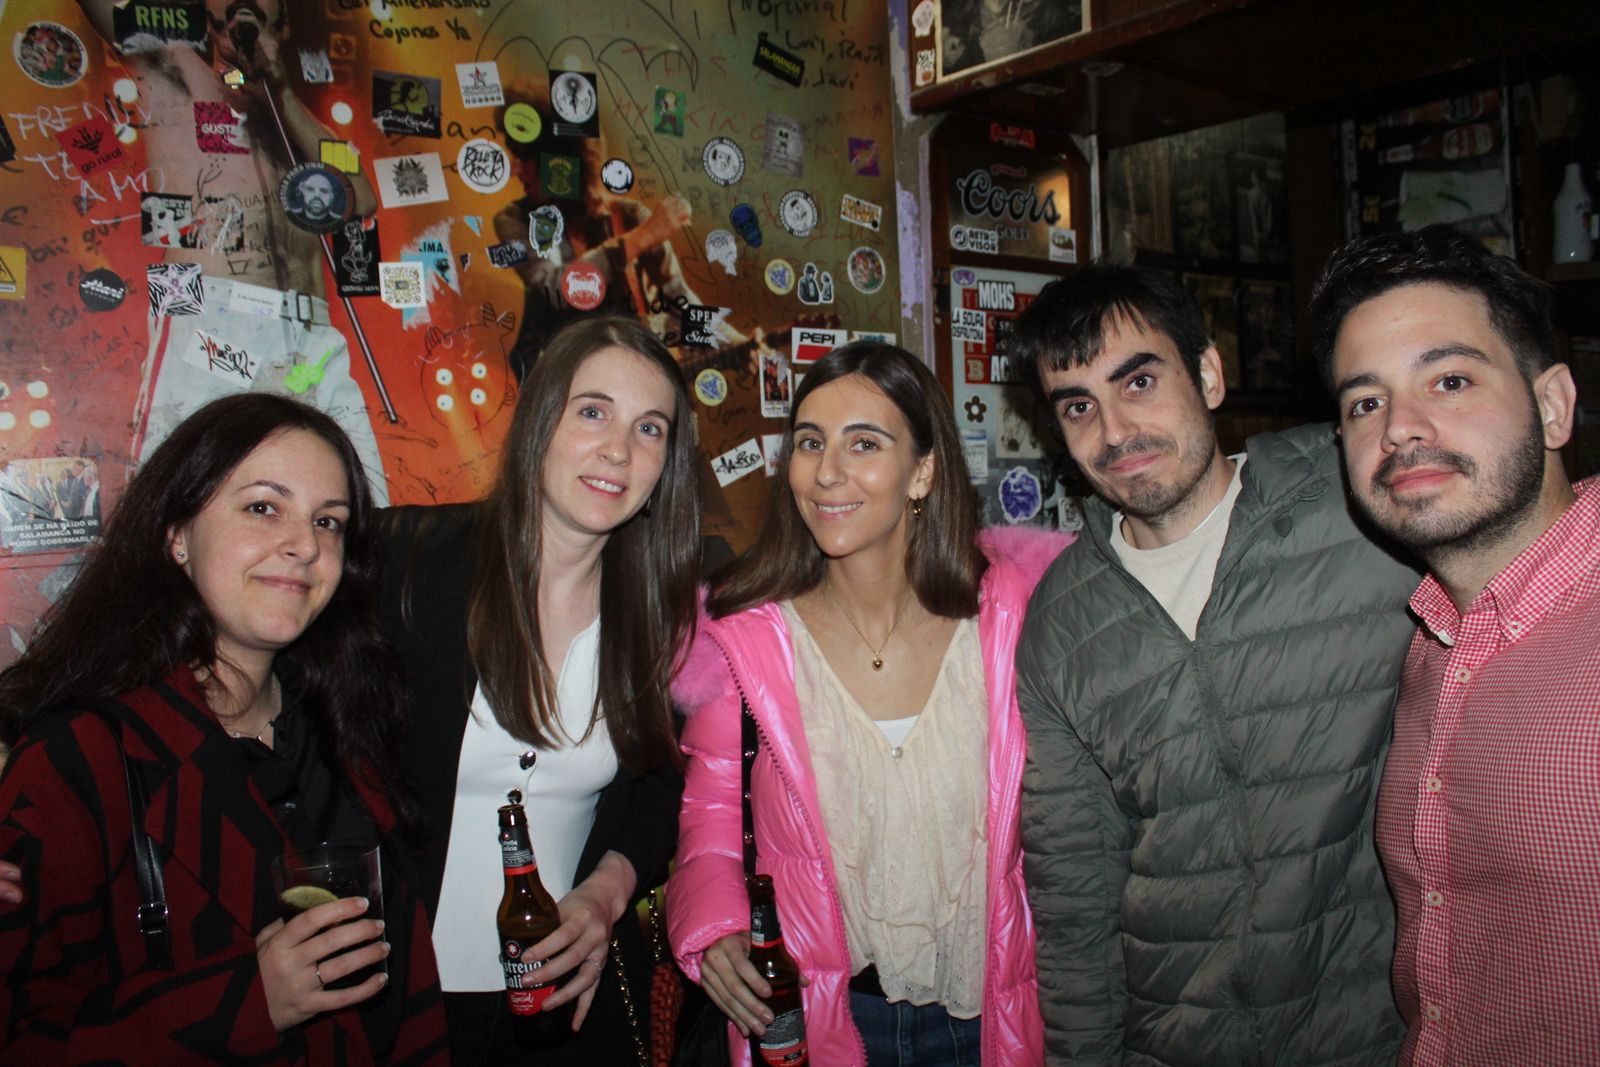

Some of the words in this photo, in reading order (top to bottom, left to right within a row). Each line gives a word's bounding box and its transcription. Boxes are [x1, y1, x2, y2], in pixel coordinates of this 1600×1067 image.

[201, 122, 236, 135] GUST
[80, 161, 98, 175] go
[96, 147, 123, 167] rural
[956, 168, 1061, 225] Coors
[968, 230, 996, 241] RETRO
[994, 223, 1031, 241] GOLD
[968, 240, 996, 252] VISOR
[977, 280, 1015, 310] MOHS
[951, 309, 960, 324] LA
[799, 332, 835, 345] PEPI
[72, 527, 86, 536] NO
